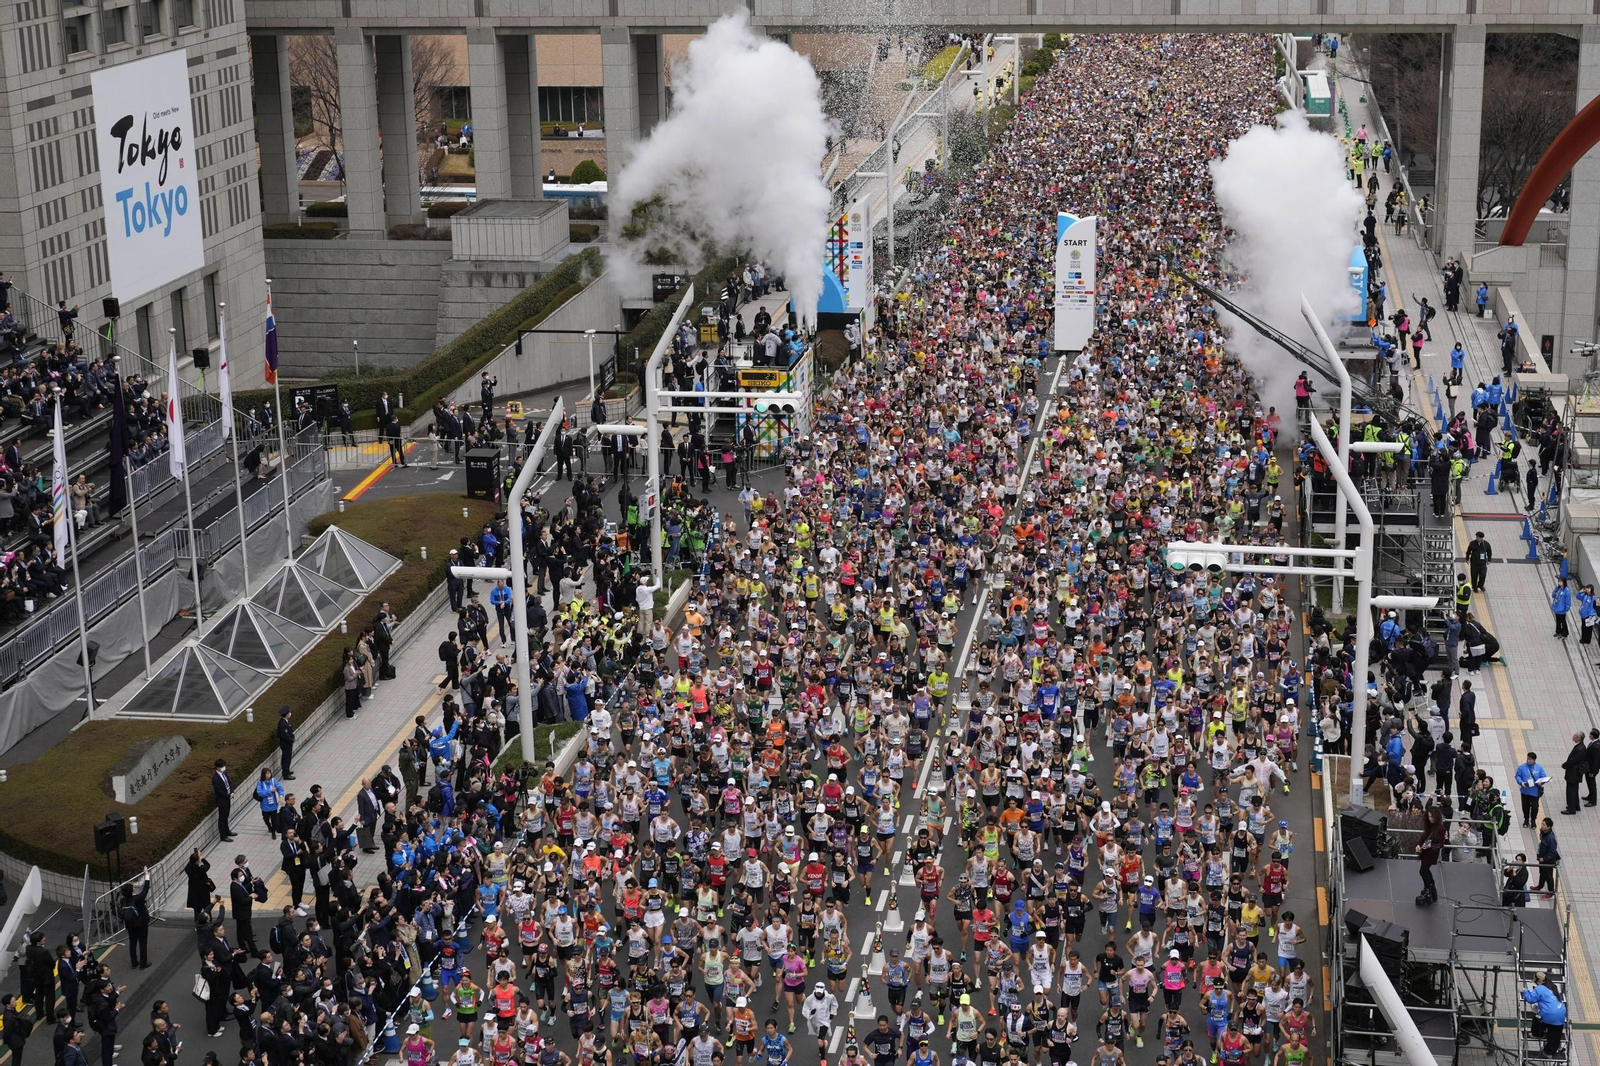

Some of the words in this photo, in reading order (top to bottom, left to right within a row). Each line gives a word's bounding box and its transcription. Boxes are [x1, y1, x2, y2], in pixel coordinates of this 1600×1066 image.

[152, 112, 160, 120] Old
[160, 109, 171, 117] meets
[110, 111, 182, 187] Tokyo
[115, 181, 188, 238] Tokyo
[674, 276, 680, 284] P
